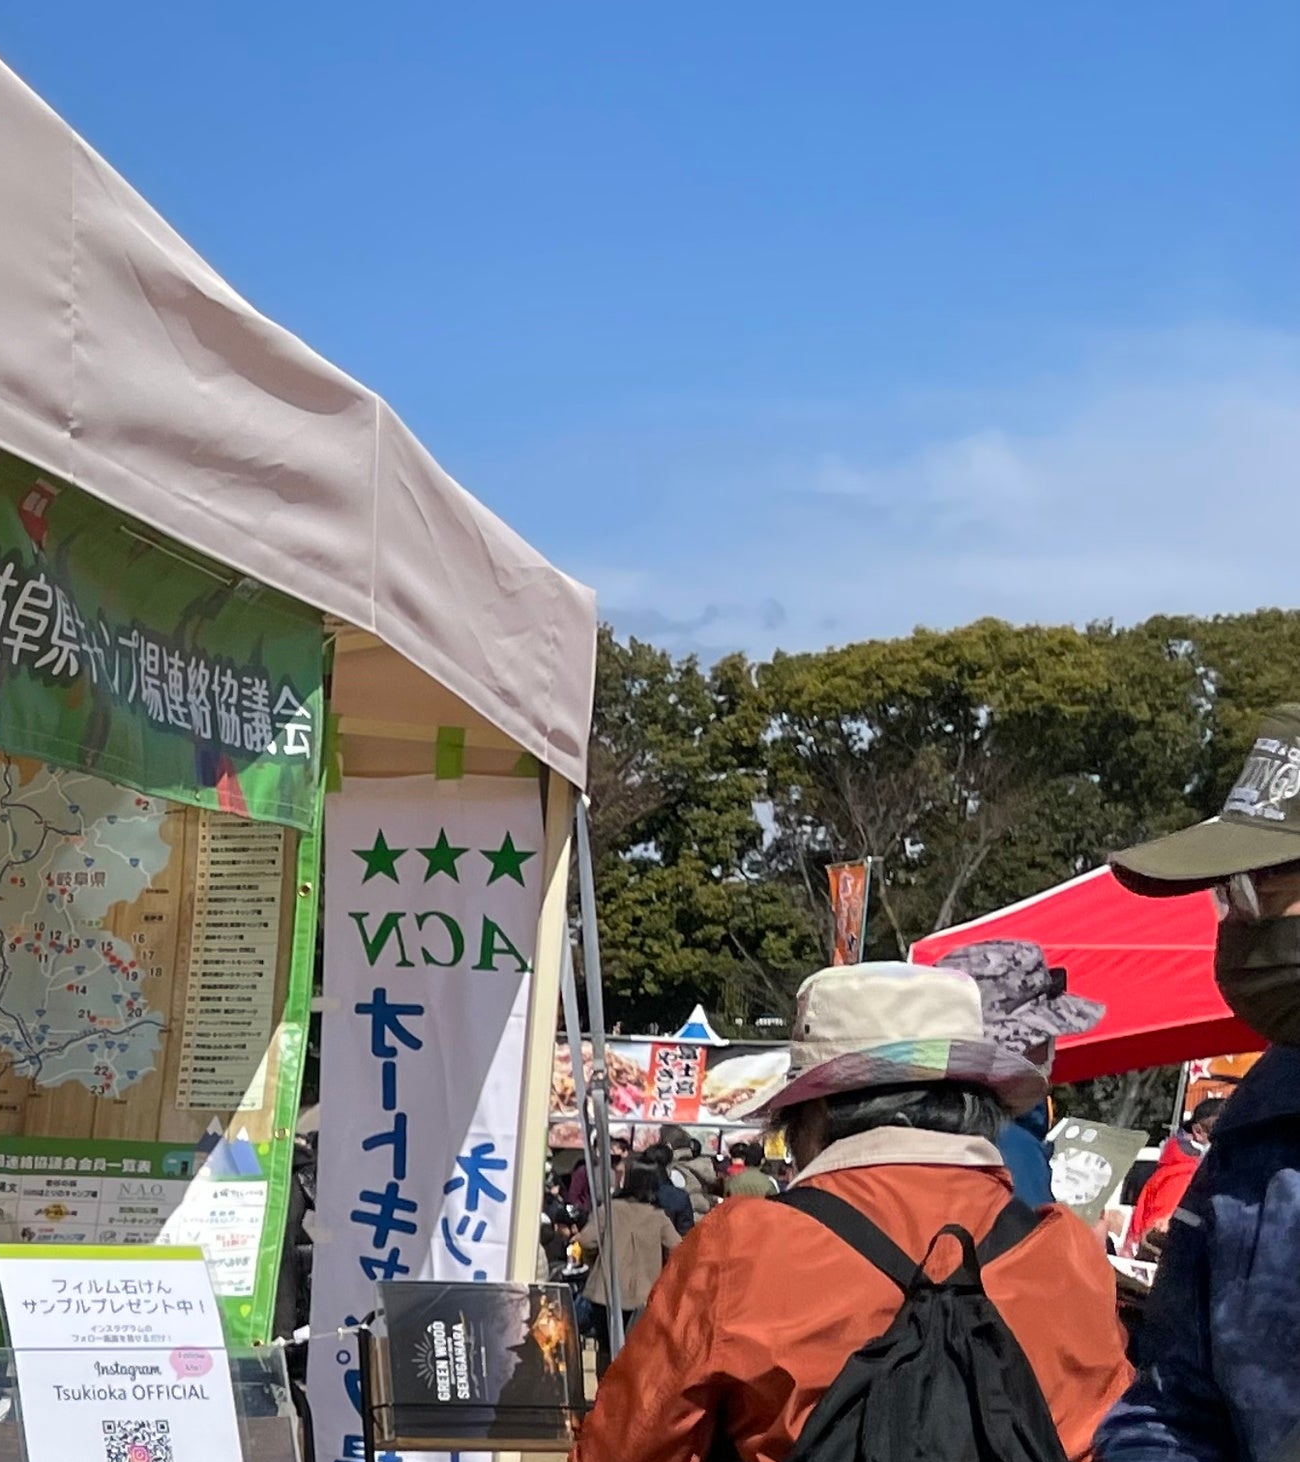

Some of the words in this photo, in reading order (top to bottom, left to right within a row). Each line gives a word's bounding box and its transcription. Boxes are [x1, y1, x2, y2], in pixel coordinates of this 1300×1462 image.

[56, 871, 106, 888] 岐阜県
[49, 930, 62, 941] 12
[125, 970, 139, 982] 19
[74, 984, 87, 995] 14
[51, 1278, 173, 1296] フィルム石けん
[93, 1360, 163, 1381] Instagram
[436, 1358, 450, 1402] GREEN
[52, 1384, 128, 1402] Tsukioka
[132, 1383, 210, 1402] OFFICIAL
